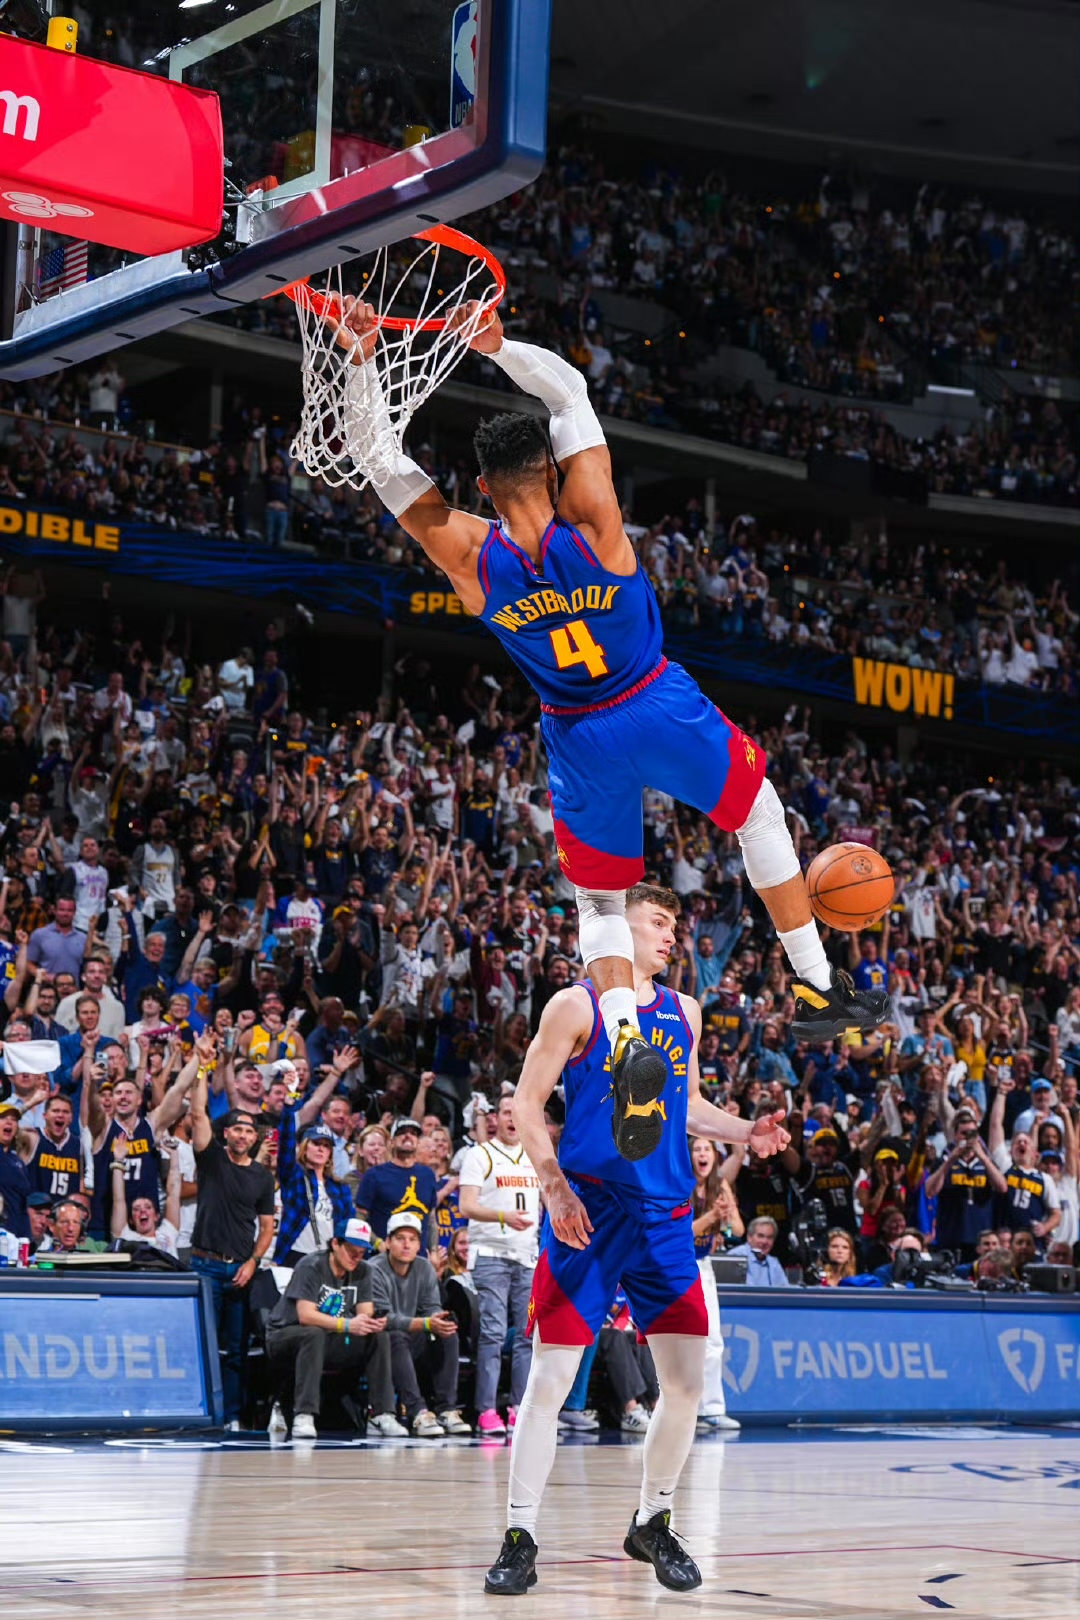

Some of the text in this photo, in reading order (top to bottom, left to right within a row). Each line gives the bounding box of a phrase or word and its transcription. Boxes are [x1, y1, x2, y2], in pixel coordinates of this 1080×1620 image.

[0, 507, 119, 552] DIBLE
[410, 591, 477, 617] SPE
[490, 585, 620, 632] WESTBROOK
[549, 619, 610, 679] 4
[853, 657, 955, 721] WOW!
[655, 1010, 681, 1021] ibotta
[651, 1026, 687, 1076] HIGH
[39, 1153, 79, 1174] DENVER
[495, 1175, 540, 1189] NUGGETS
[50, 1170, 69, 1196] 15
[829, 1188, 847, 1207] 15
[1012, 1187, 1032, 1209] 15
[0, 1334, 187, 1379] NDUEL
[772, 1340, 948, 1380] FANDUEL
[1055, 1343, 1080, 1381] F
